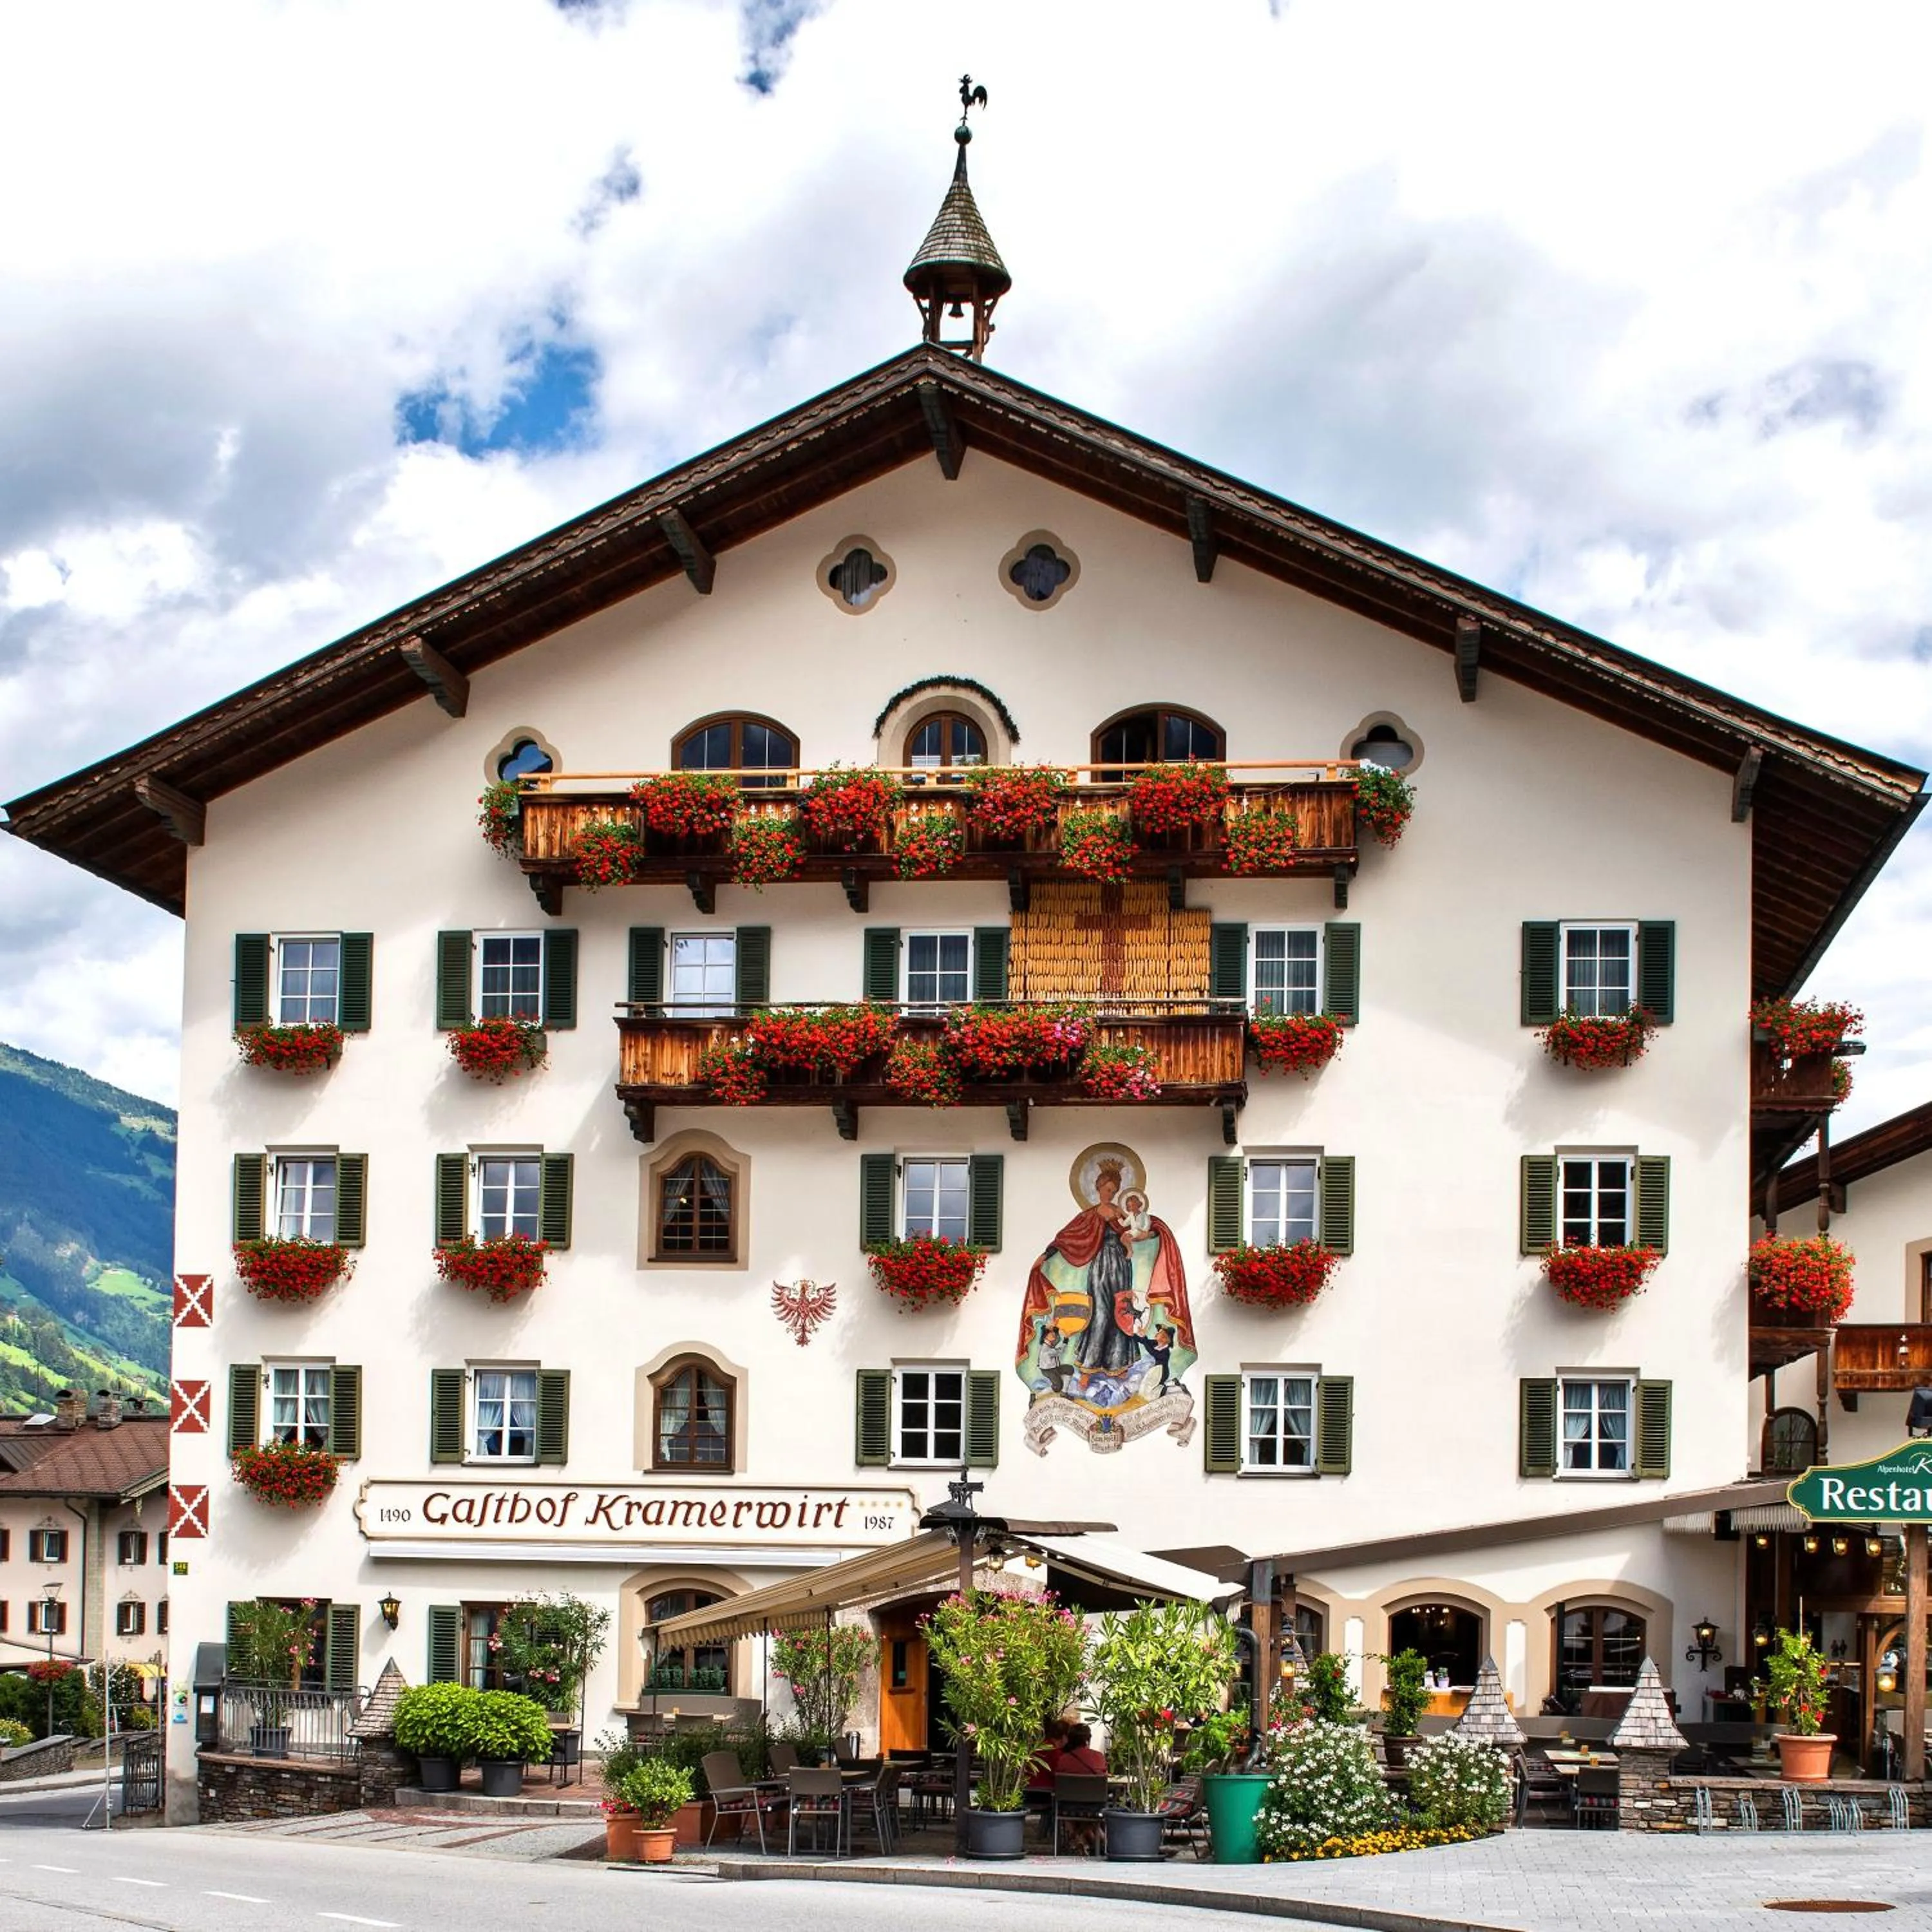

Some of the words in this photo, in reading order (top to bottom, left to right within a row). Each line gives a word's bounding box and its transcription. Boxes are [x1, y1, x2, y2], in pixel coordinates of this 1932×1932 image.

[1877, 1464, 1915, 1475] Alpenhotel
[380, 1508, 412, 1523] 1490
[584, 1493, 851, 1531] Kramerwirt
[864, 1515, 895, 1530] 1987
